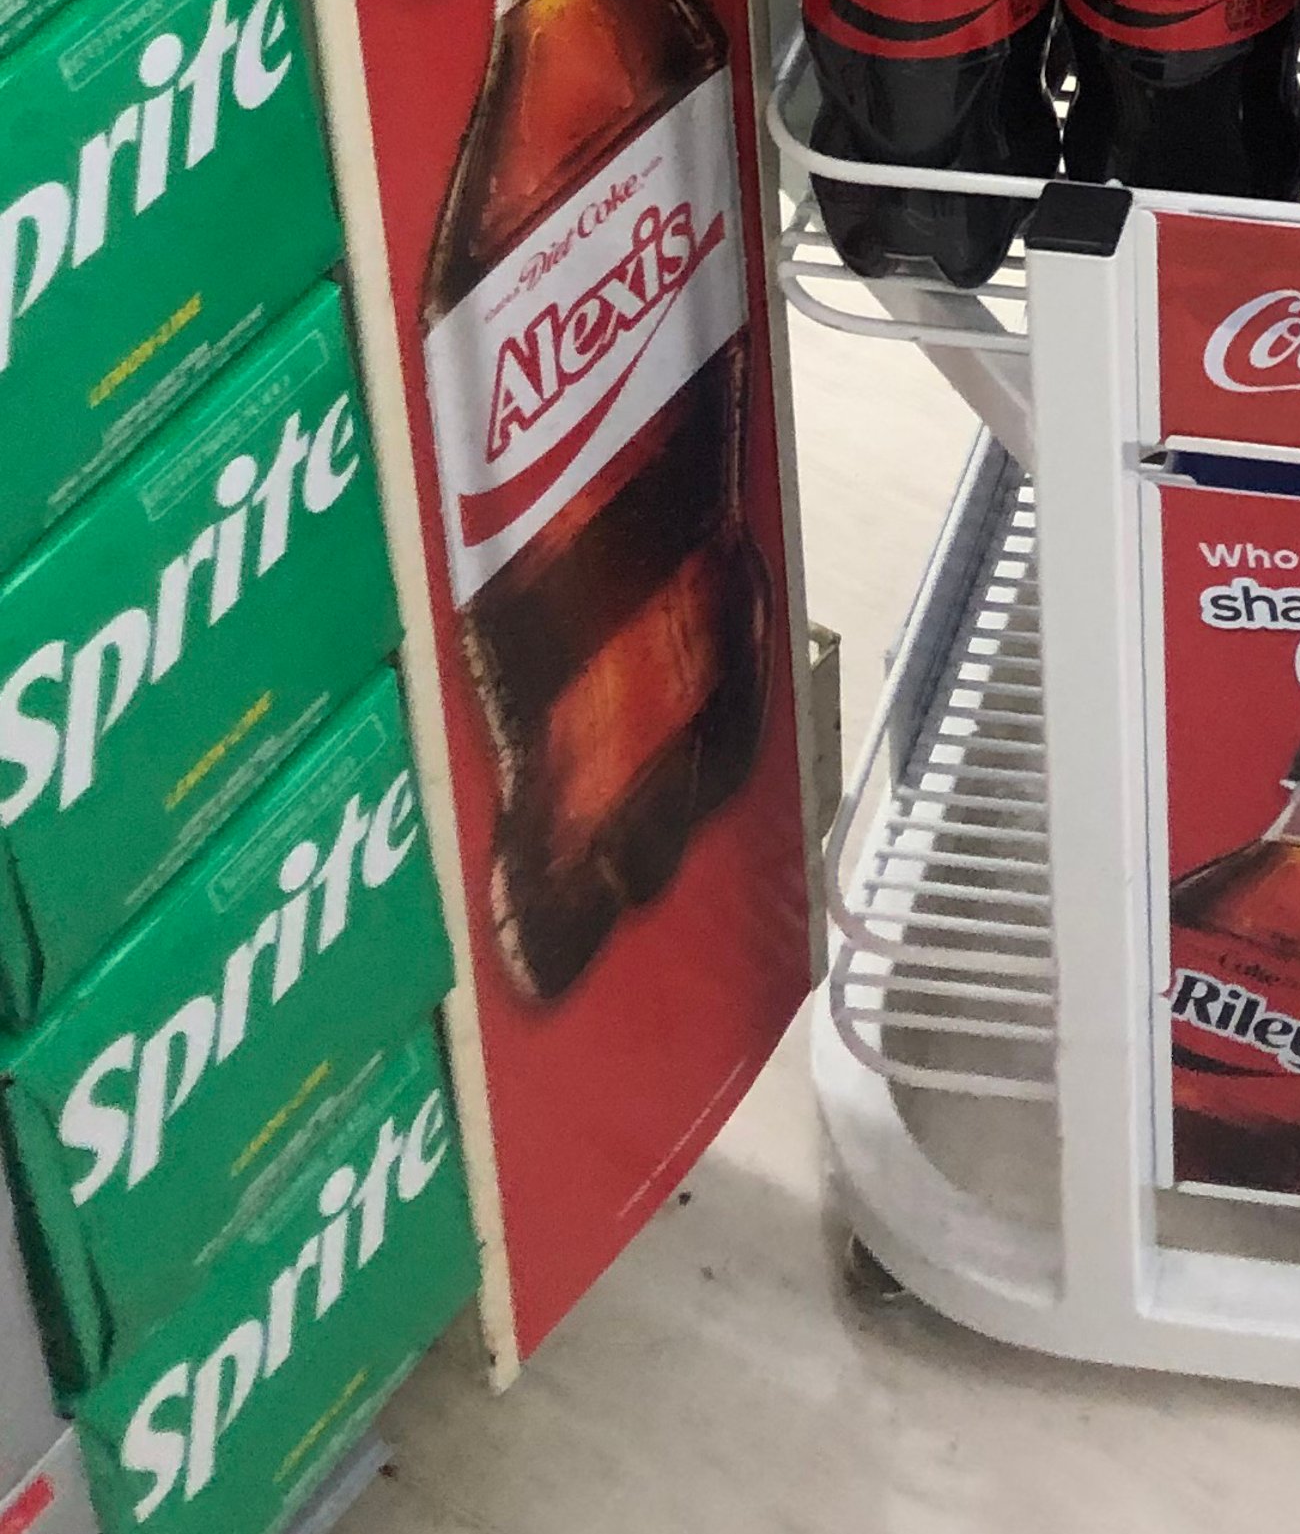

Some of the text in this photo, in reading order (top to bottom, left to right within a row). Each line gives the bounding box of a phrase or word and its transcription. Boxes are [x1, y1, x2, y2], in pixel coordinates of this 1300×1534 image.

[486, 201, 695, 464] Alexis
[577, 174, 639, 239] Coke
[0, 390, 361, 828] Sprite
[1199, 541, 1299, 571] Who
[58, 768, 418, 1208] Sprite
[121, 1087, 450, 1524] Sprite
